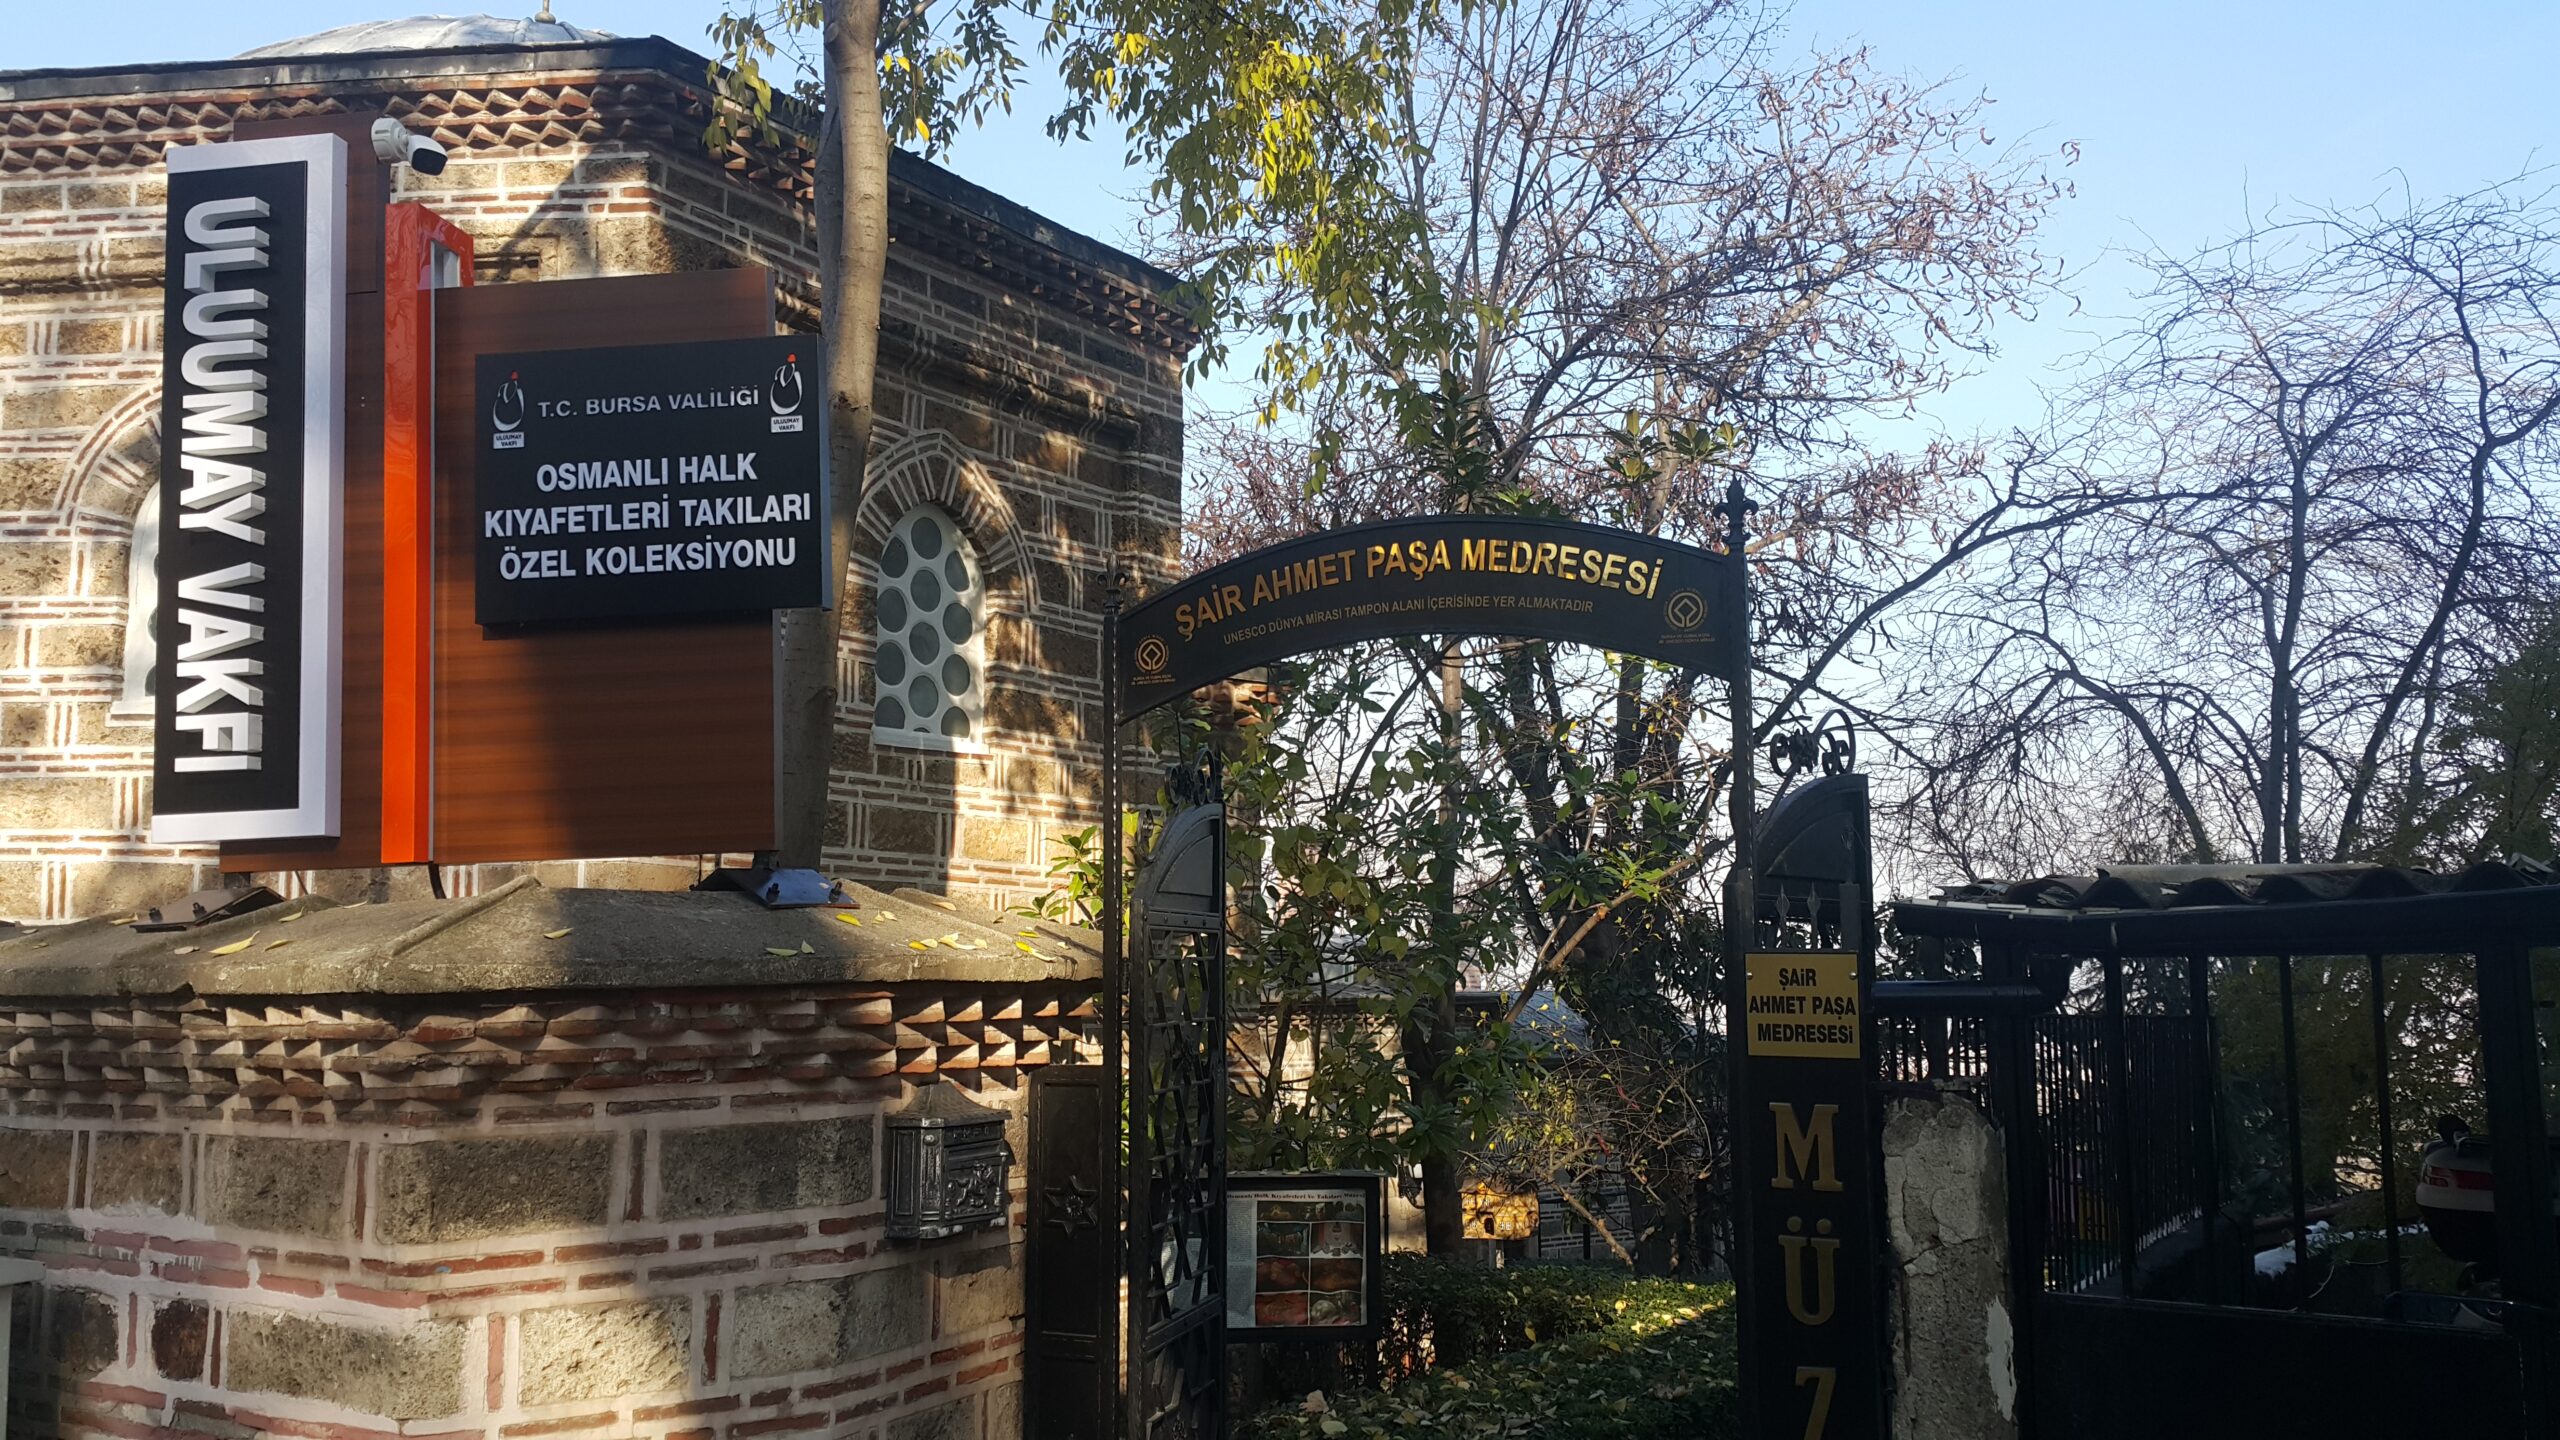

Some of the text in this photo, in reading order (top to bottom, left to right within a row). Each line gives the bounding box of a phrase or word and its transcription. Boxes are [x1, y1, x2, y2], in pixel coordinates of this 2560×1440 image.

[537, 384, 760, 419] T.C. BURSA VALİLİĞİ
[174, 195, 270, 773] ULUUMAY VAKFI
[536, 452, 759, 493] OSMANLI HALK
[484, 492, 811, 538] KIYAFETLERİ TAKILARI
[499, 534, 797, 581] ÖZEL KOLEKSİYONU
[1175, 538, 1664, 642] ŞAİR AHMET PAŞA MEDRESESİ
[1223, 592, 1594, 645] UNESCO DÜNYA MİRASI TAMPON ALANI İÇERİSİNDE YER ALMAKTADIR
[1748, 995, 1857, 1020] AHMET PAŞA
